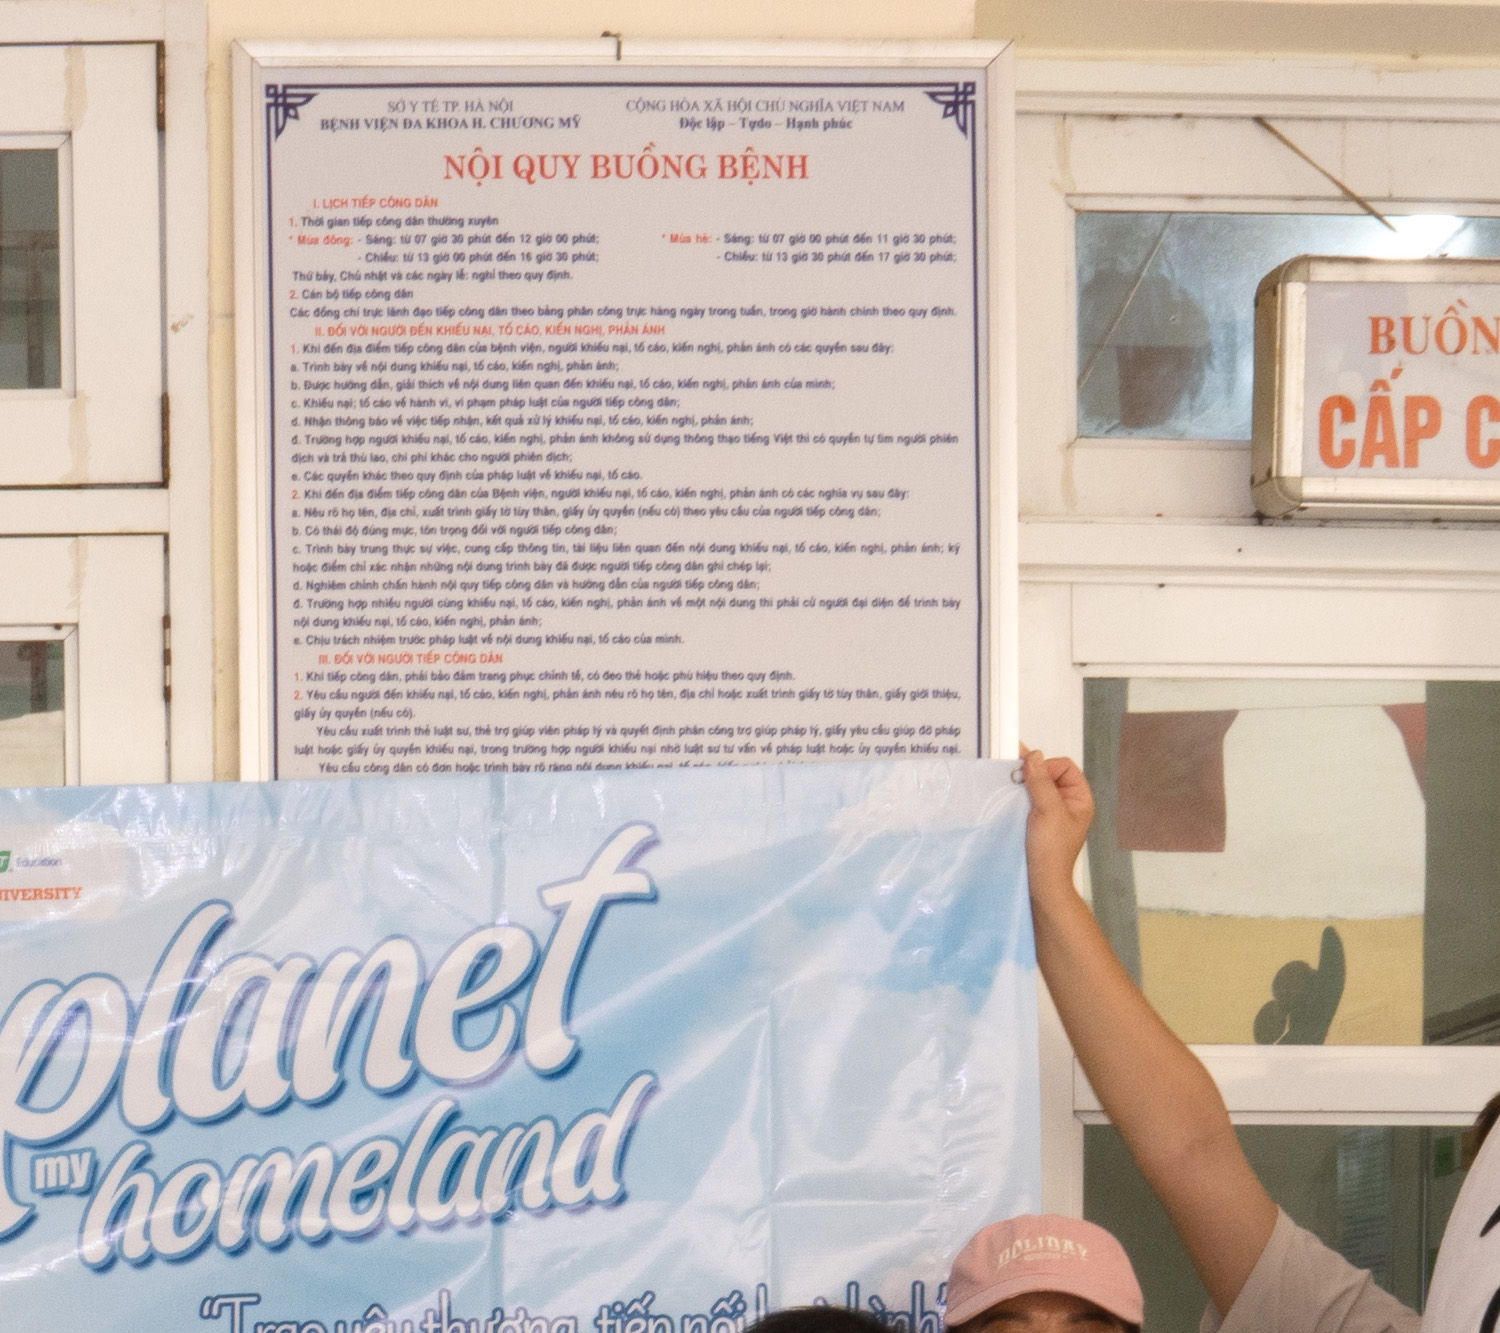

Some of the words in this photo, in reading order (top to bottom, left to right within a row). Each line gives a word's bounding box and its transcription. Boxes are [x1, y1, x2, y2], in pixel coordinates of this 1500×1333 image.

[410, 101, 419, 114] Y
[422, 98, 440, 114] TẾ
[442, 100, 462, 113] TP.
[465, 98, 486, 113] HÀ
[489, 98, 514, 114] NỘI
[626, 97, 666, 114] CỘNG
[670, 98, 700, 112] HÒA
[704, 98, 724, 112] XÃ
[728, 98, 752, 114] HỘI
[756, 98, 786, 113] CHỦ
[790, 98, 834, 113] NGHĨA
[838, 99, 870, 114] VIỆT
[872, 100, 906, 113] NAM
[320, 118, 360, 134] BỆNH
[364, 117, 399, 134] VIỆN
[403, 118, 423, 130] ĐA
[426, 118, 470, 130] KHOA
[472, 118, 487, 130] H.
[490, 116, 555, 130] CHƯƠNG
[559, 114, 582, 129] MỸ
[444, 146, 504, 188] NỘI
[513, 154, 582, 186] QUY
[591, 142, 708, 180] BUỒNG
[718, 146, 809, 186] BỆNH
[1318, 367, 1442, 469] CẤP
[16, 856, 63, 869] Education
[32, 1147, 92, 1196] my
[76, 1070, 659, 1272] homeland
